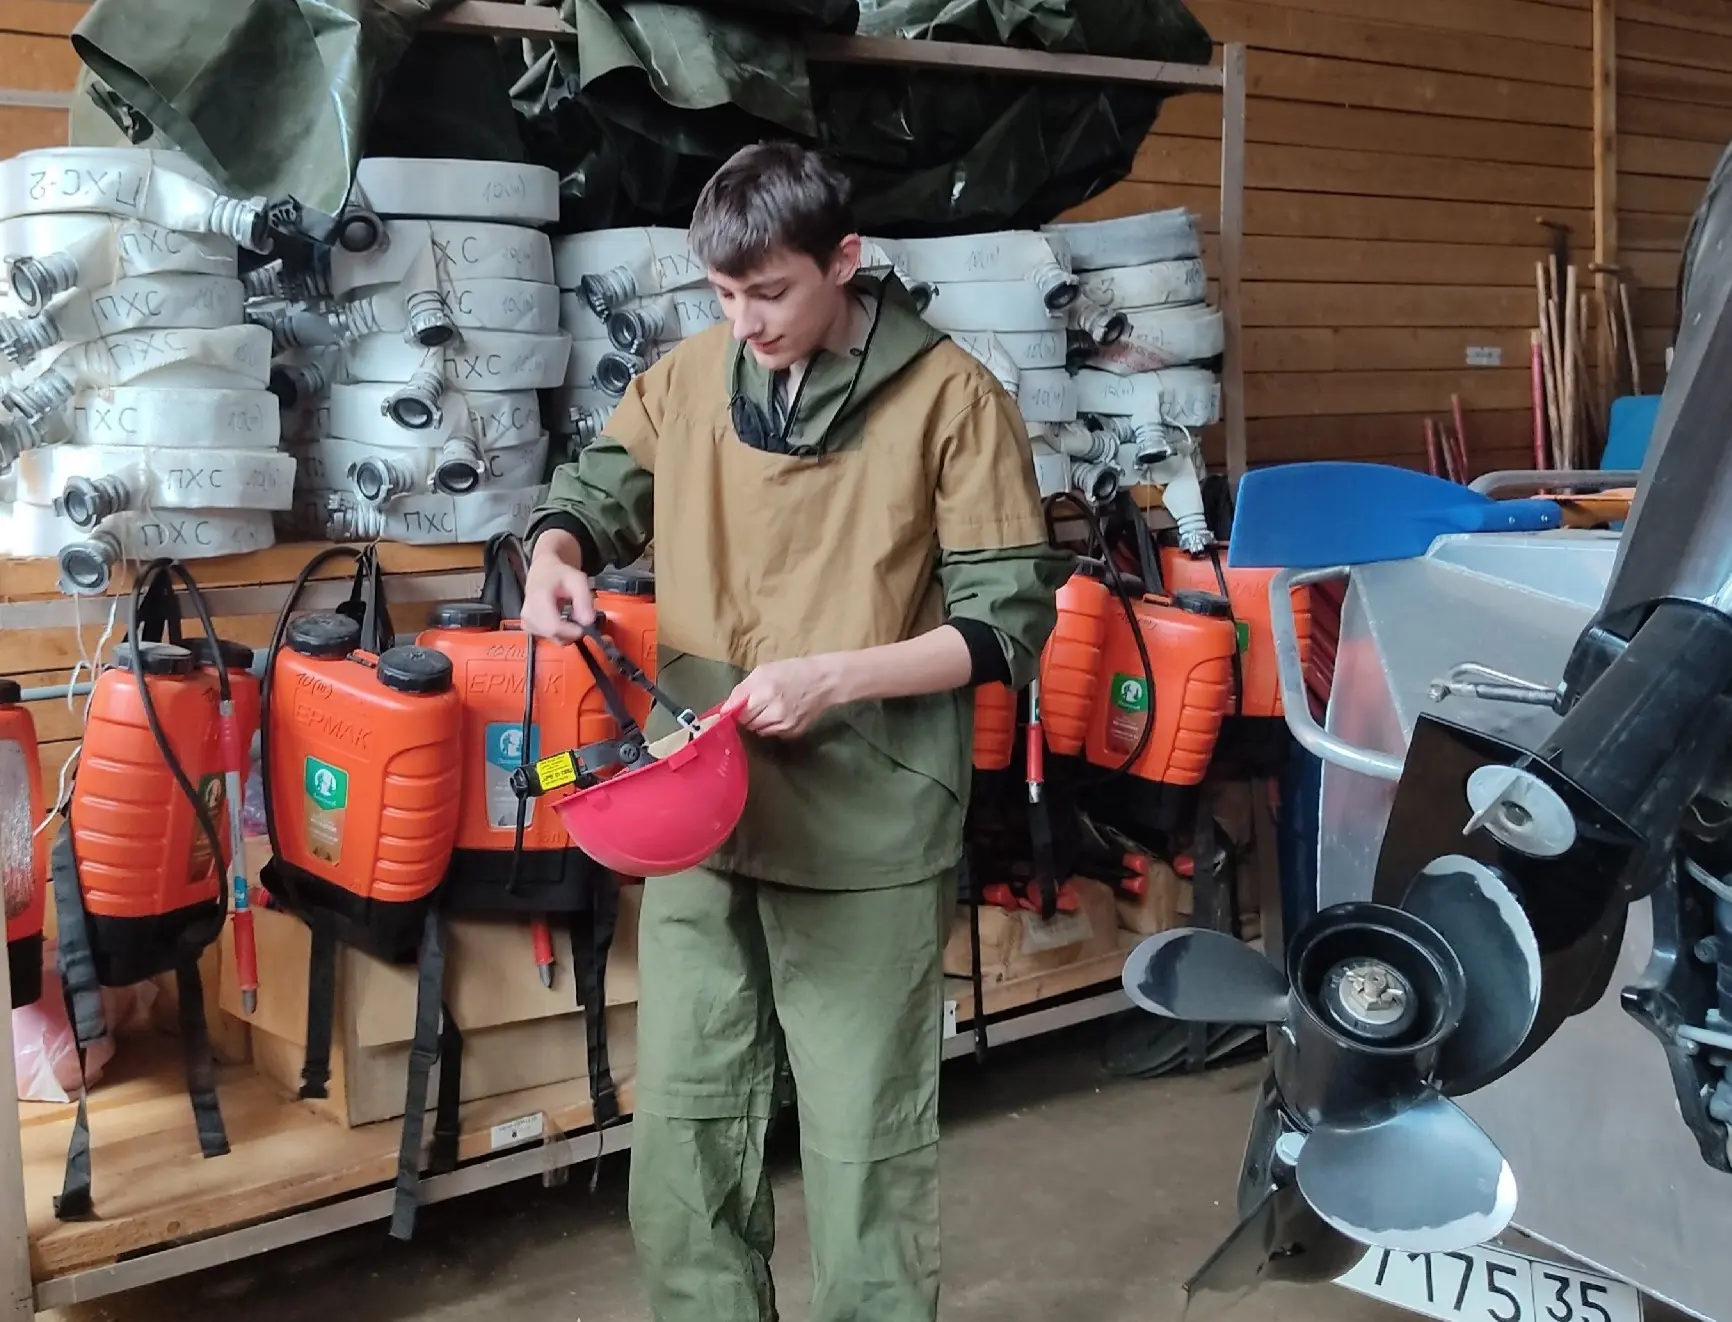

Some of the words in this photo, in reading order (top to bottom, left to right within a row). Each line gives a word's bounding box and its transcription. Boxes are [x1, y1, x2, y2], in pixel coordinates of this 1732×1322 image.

[29, 168, 143, 208] ПХС-2
[120, 229, 181, 256] ПХС
[432, 236, 479, 265] ХС
[657, 249, 701, 276] ПХ
[96, 290, 162, 321] ПХС
[108, 332, 187, 369] ПХС
[443, 354, 502, 380] ПХС
[75, 406, 138, 434] ПХС
[167, 468, 224, 489] ПХС
[141, 521, 213, 546] ПХС
[403, 512, 455, 534] ПХС
[468, 672, 564, 695] ЕРМК
[297, 704, 373, 750] ЕРМАК
[1543, 1271, 1611, 1322] 35
